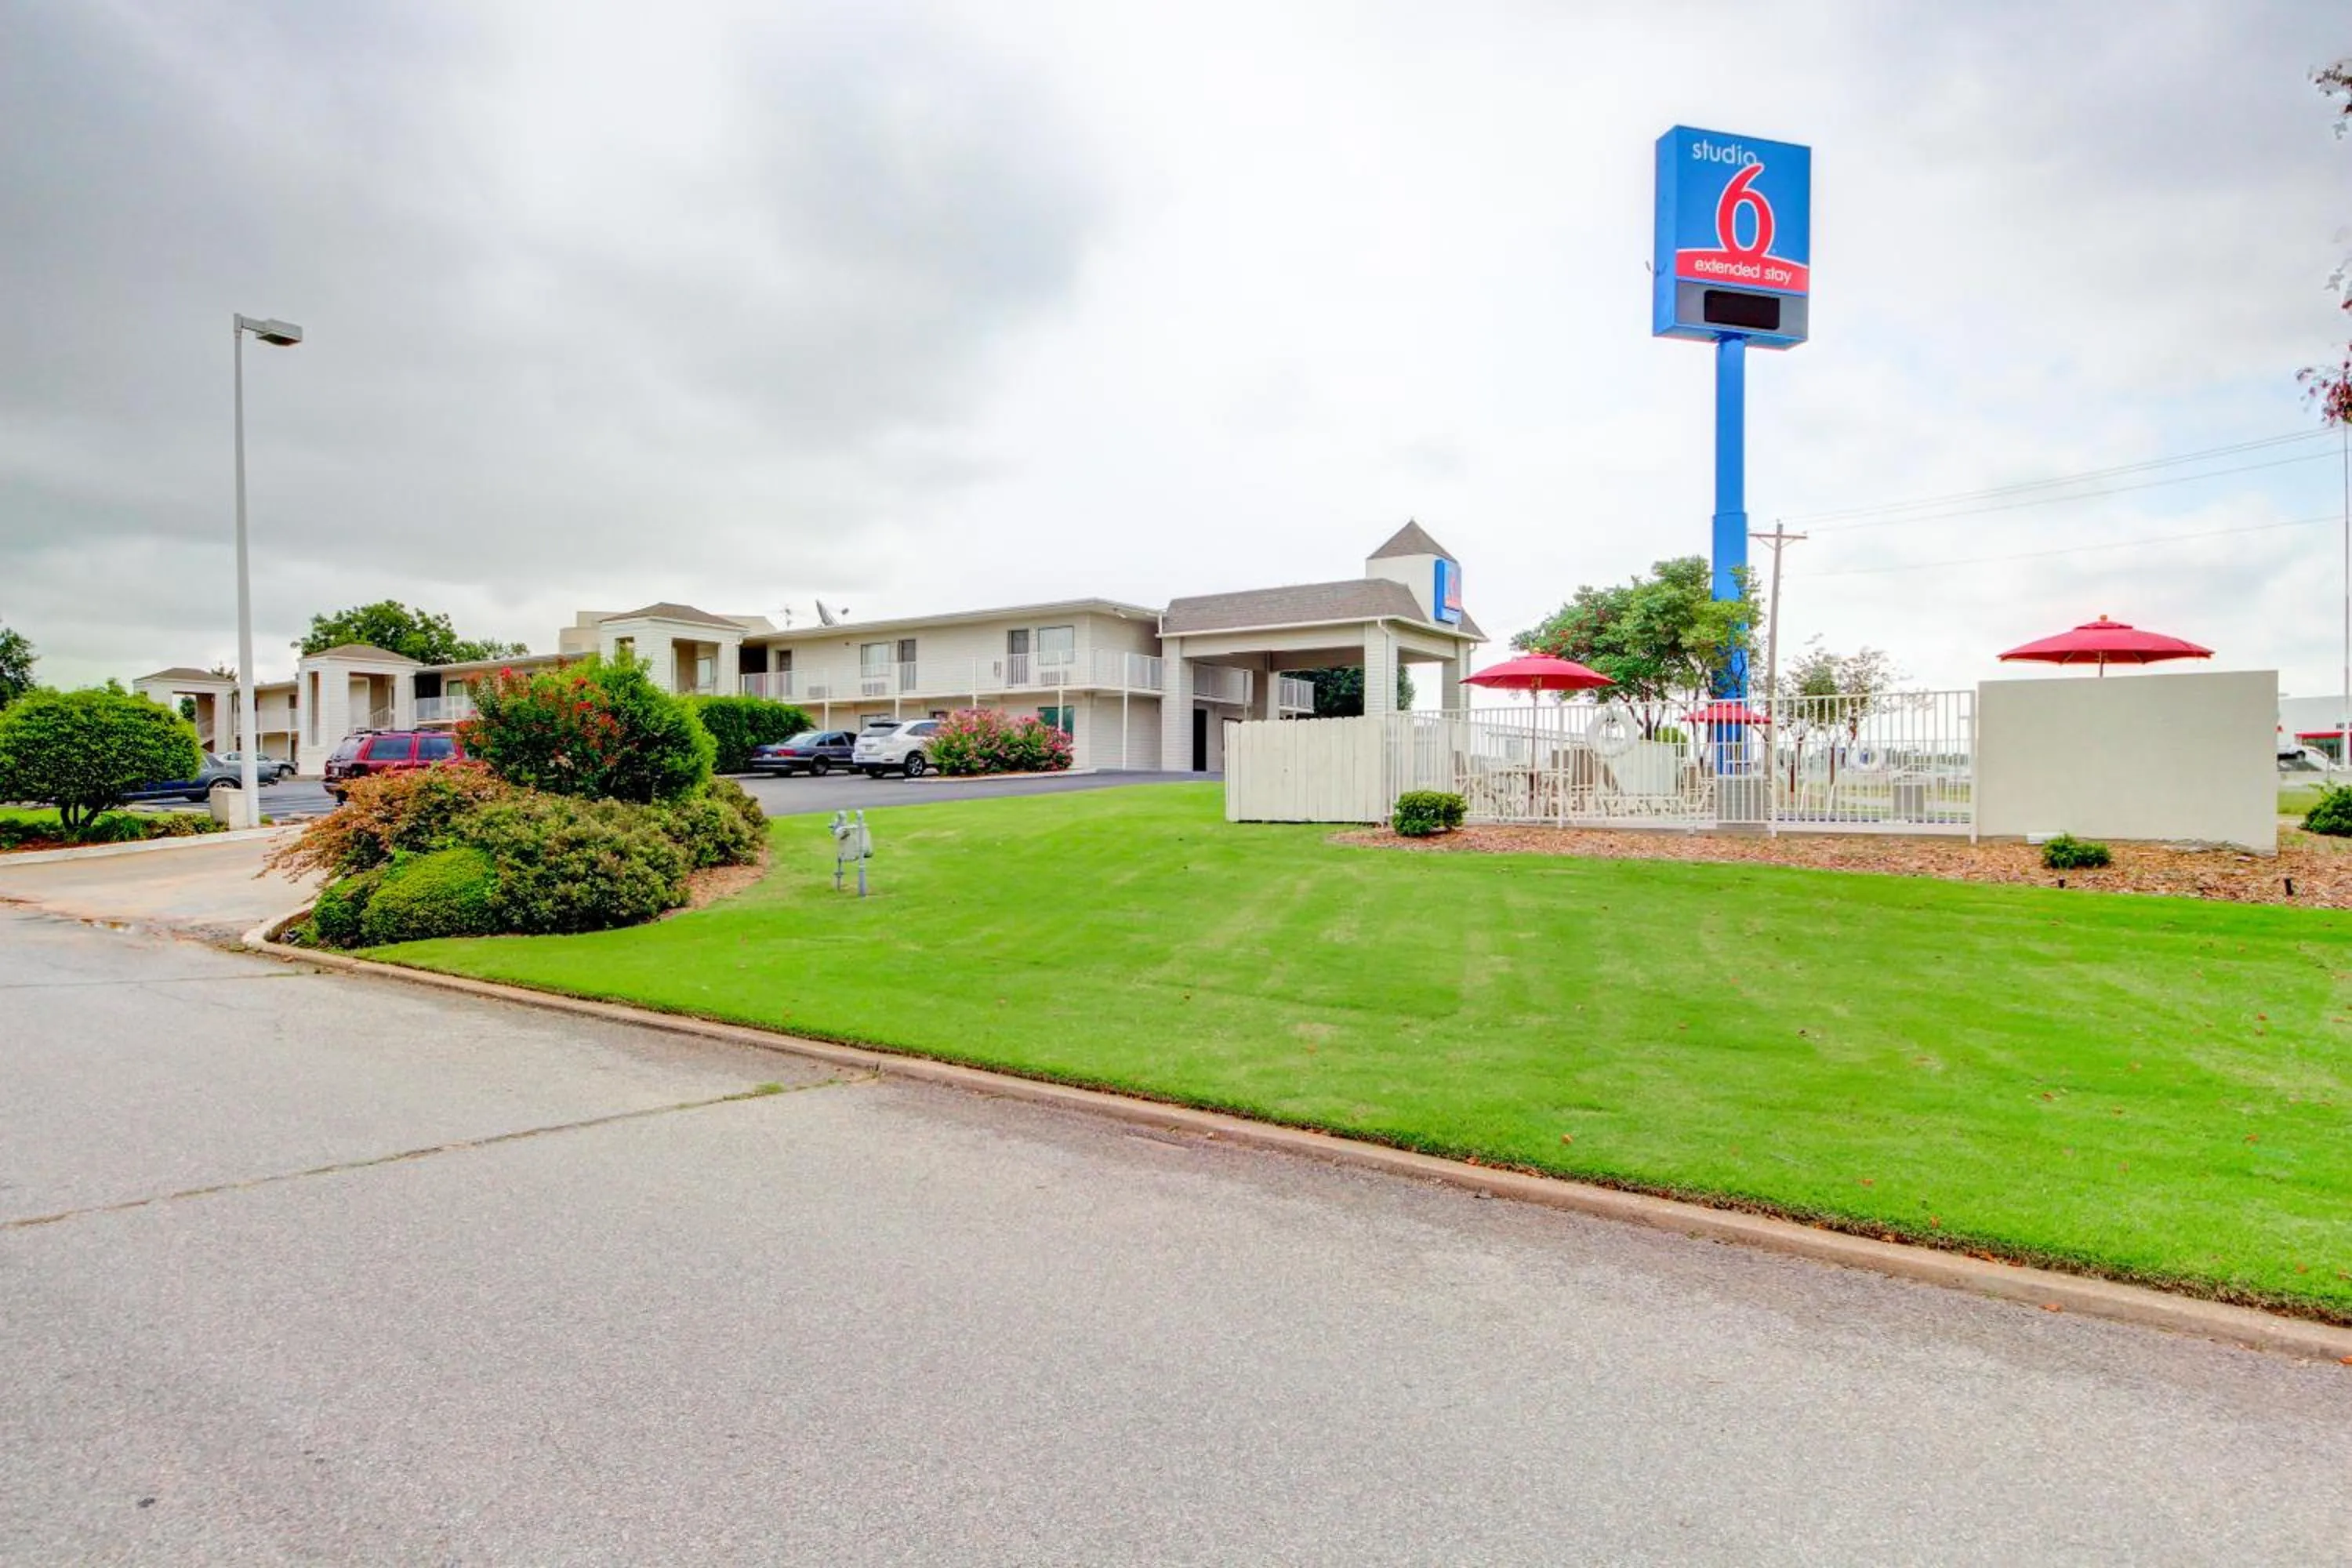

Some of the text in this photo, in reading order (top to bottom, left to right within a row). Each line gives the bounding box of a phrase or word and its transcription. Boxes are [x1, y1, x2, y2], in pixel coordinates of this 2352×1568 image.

[1693, 139, 1757, 166] studio
[1715, 162, 1775, 256] 6
[1694, 258, 1792, 285] extended stay
